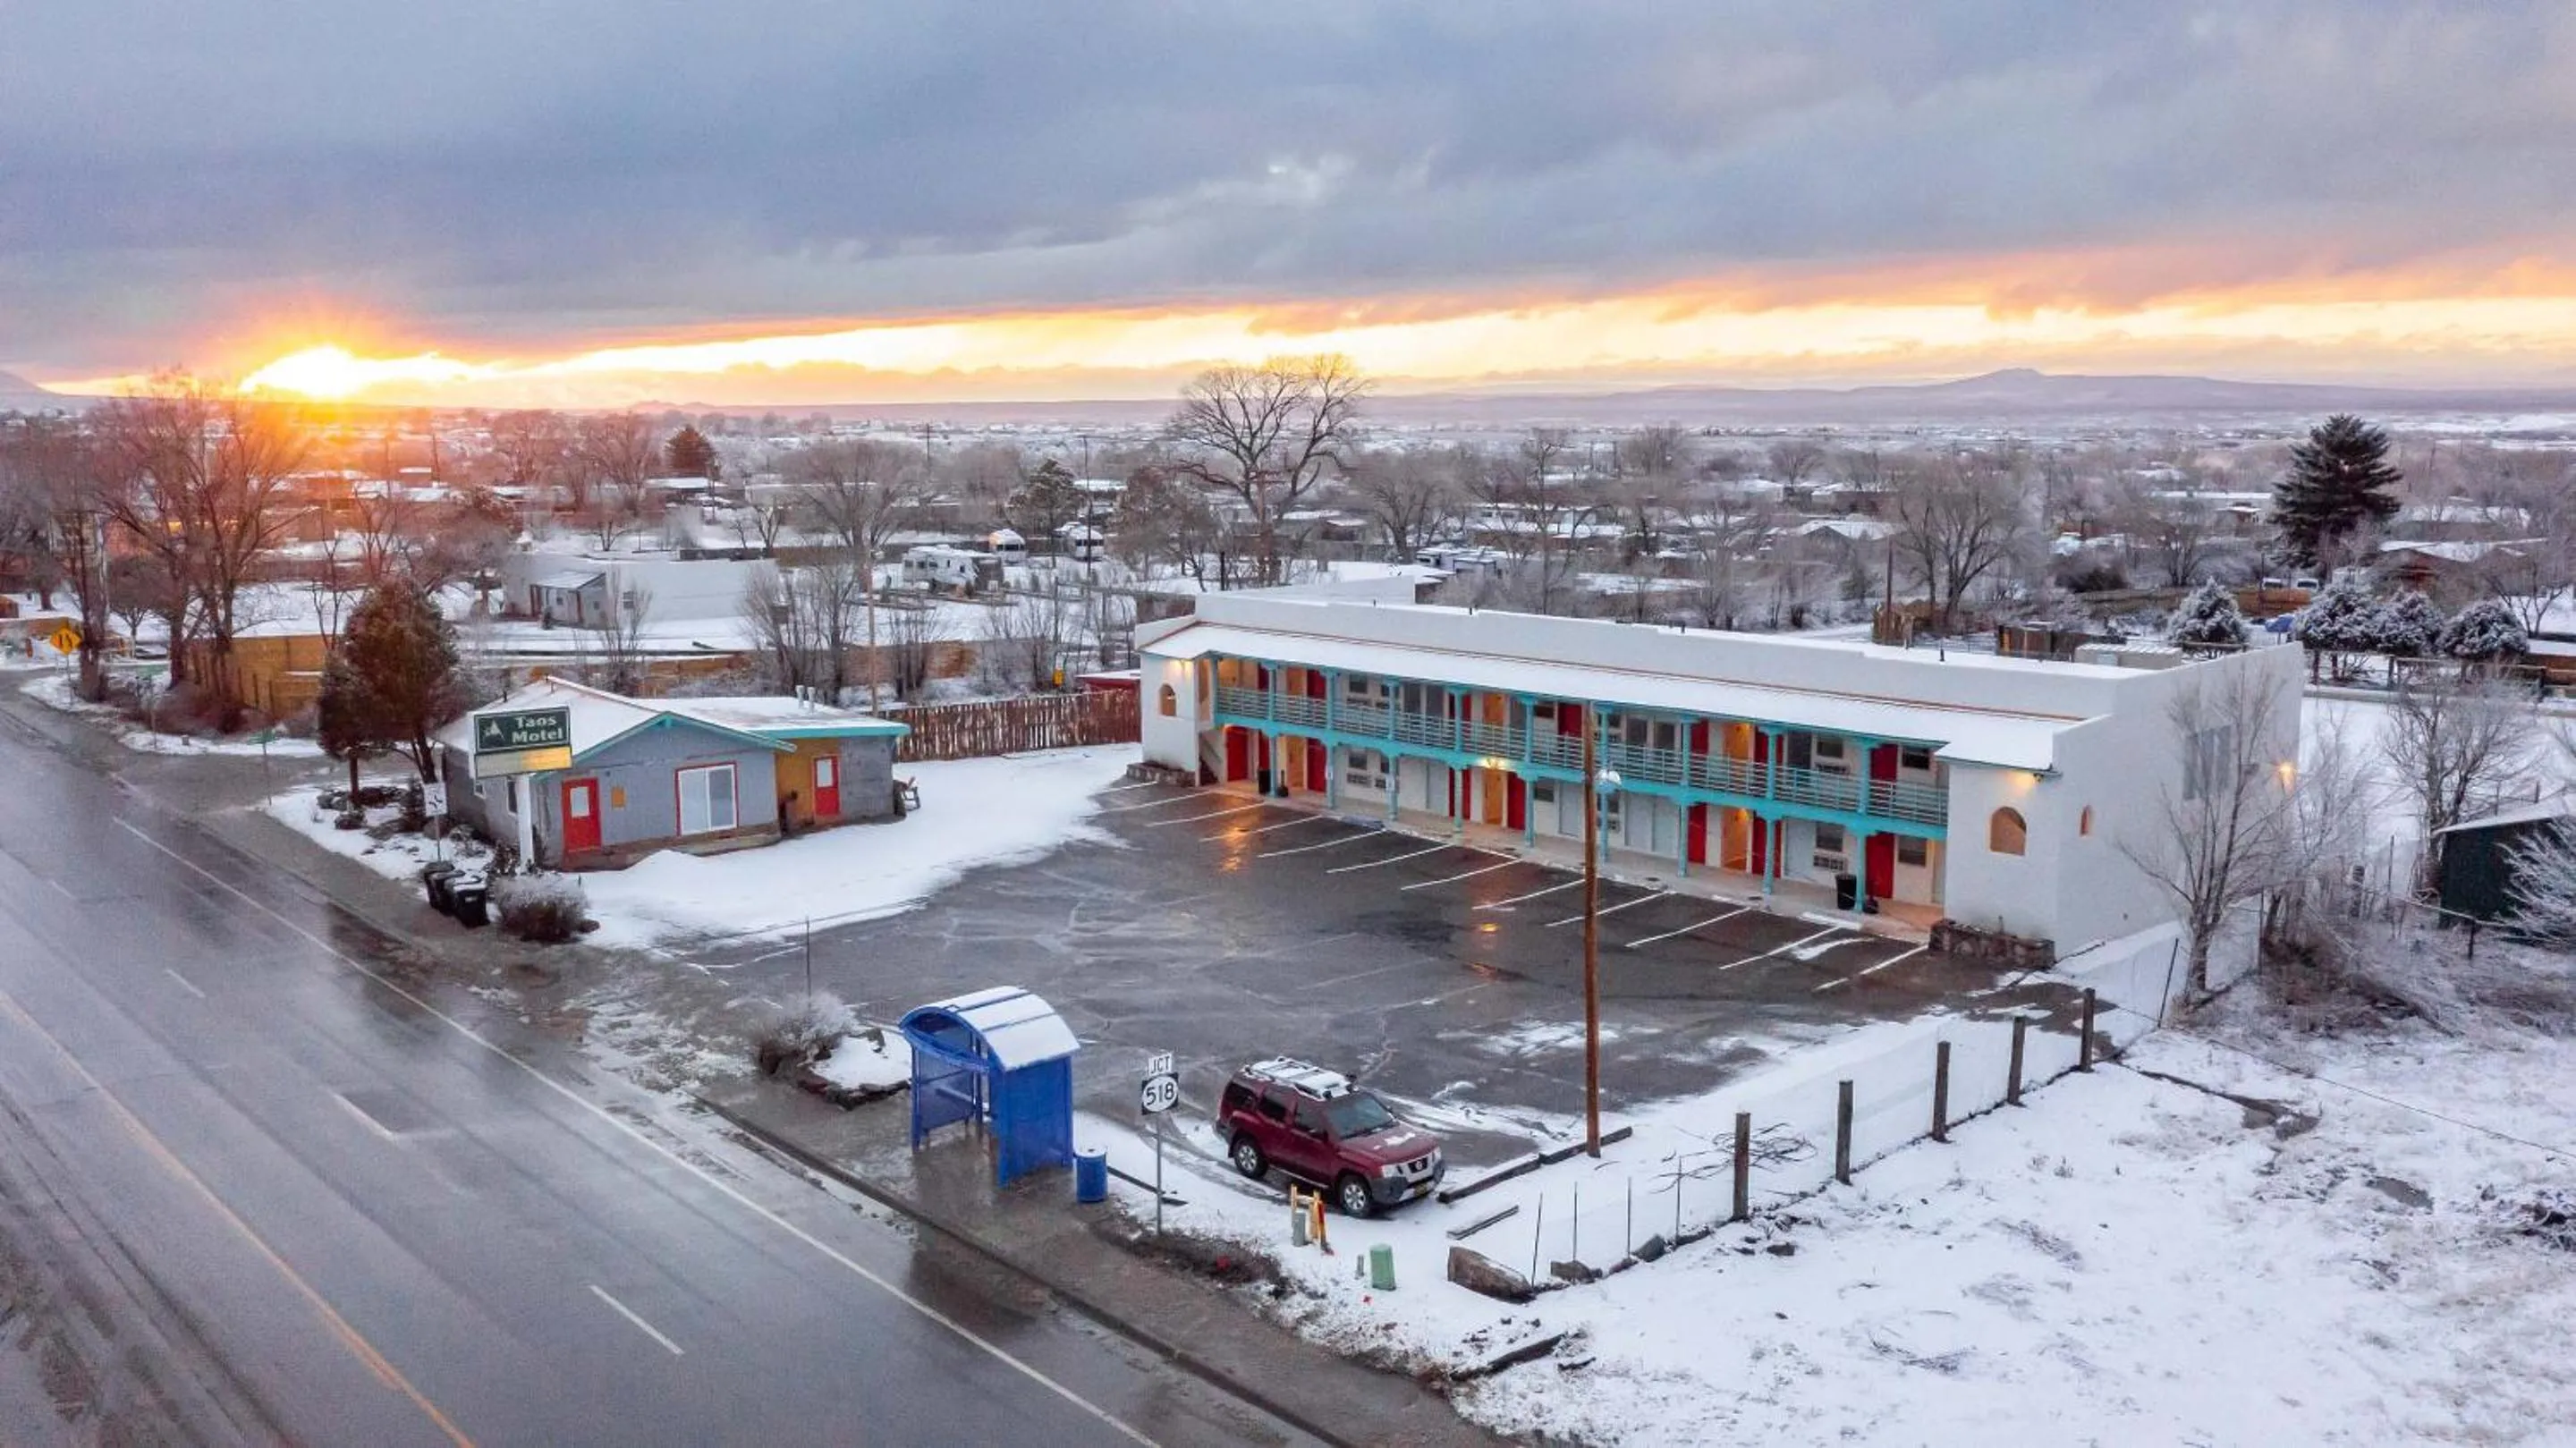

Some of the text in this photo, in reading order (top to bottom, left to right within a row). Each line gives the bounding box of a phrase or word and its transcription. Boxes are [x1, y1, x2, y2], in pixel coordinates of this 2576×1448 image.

[514, 716, 557, 729] Taos
[512, 728, 564, 743] Motel
[1150, 1055, 1170, 1073] JCT
[1146, 1081, 1174, 1105] 518
